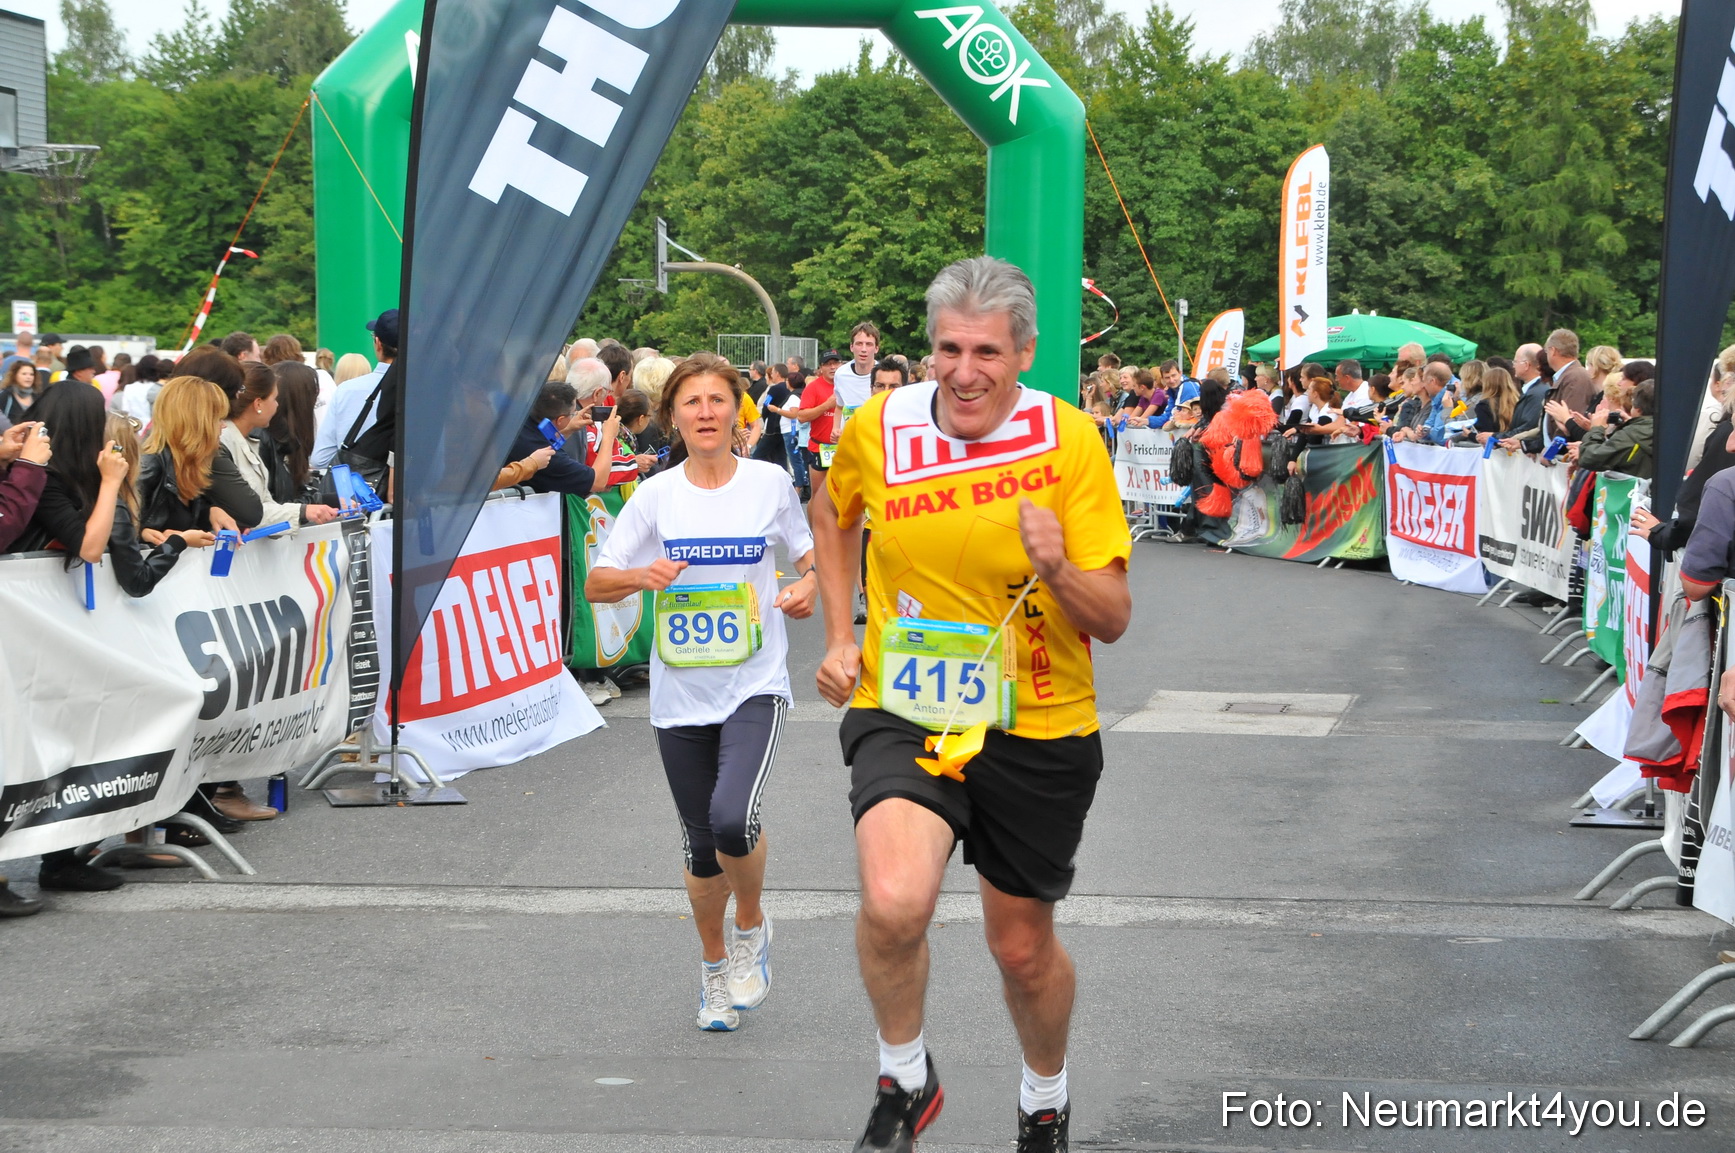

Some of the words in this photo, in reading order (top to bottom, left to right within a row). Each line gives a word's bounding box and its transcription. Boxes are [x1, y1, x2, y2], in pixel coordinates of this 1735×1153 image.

[914, 5, 1051, 126] AOK
[1296, 171, 1313, 295] KLEBL
[1314, 181, 1327, 266] www.klebl.de
[885, 488, 960, 522] MAX
[971, 464, 1061, 506] BÖGL
[1394, 472, 1469, 550] MEIER
[671, 544, 763, 560] STAEDTLER
[414, 553, 562, 706] MEIER
[668, 611, 739, 645] 896
[675, 646, 710, 655] Gabriele
[893, 657, 985, 704] 415
[913, 703, 946, 714] Anton
[62, 783, 91, 805] die
[90, 771, 159, 799] verbinden
